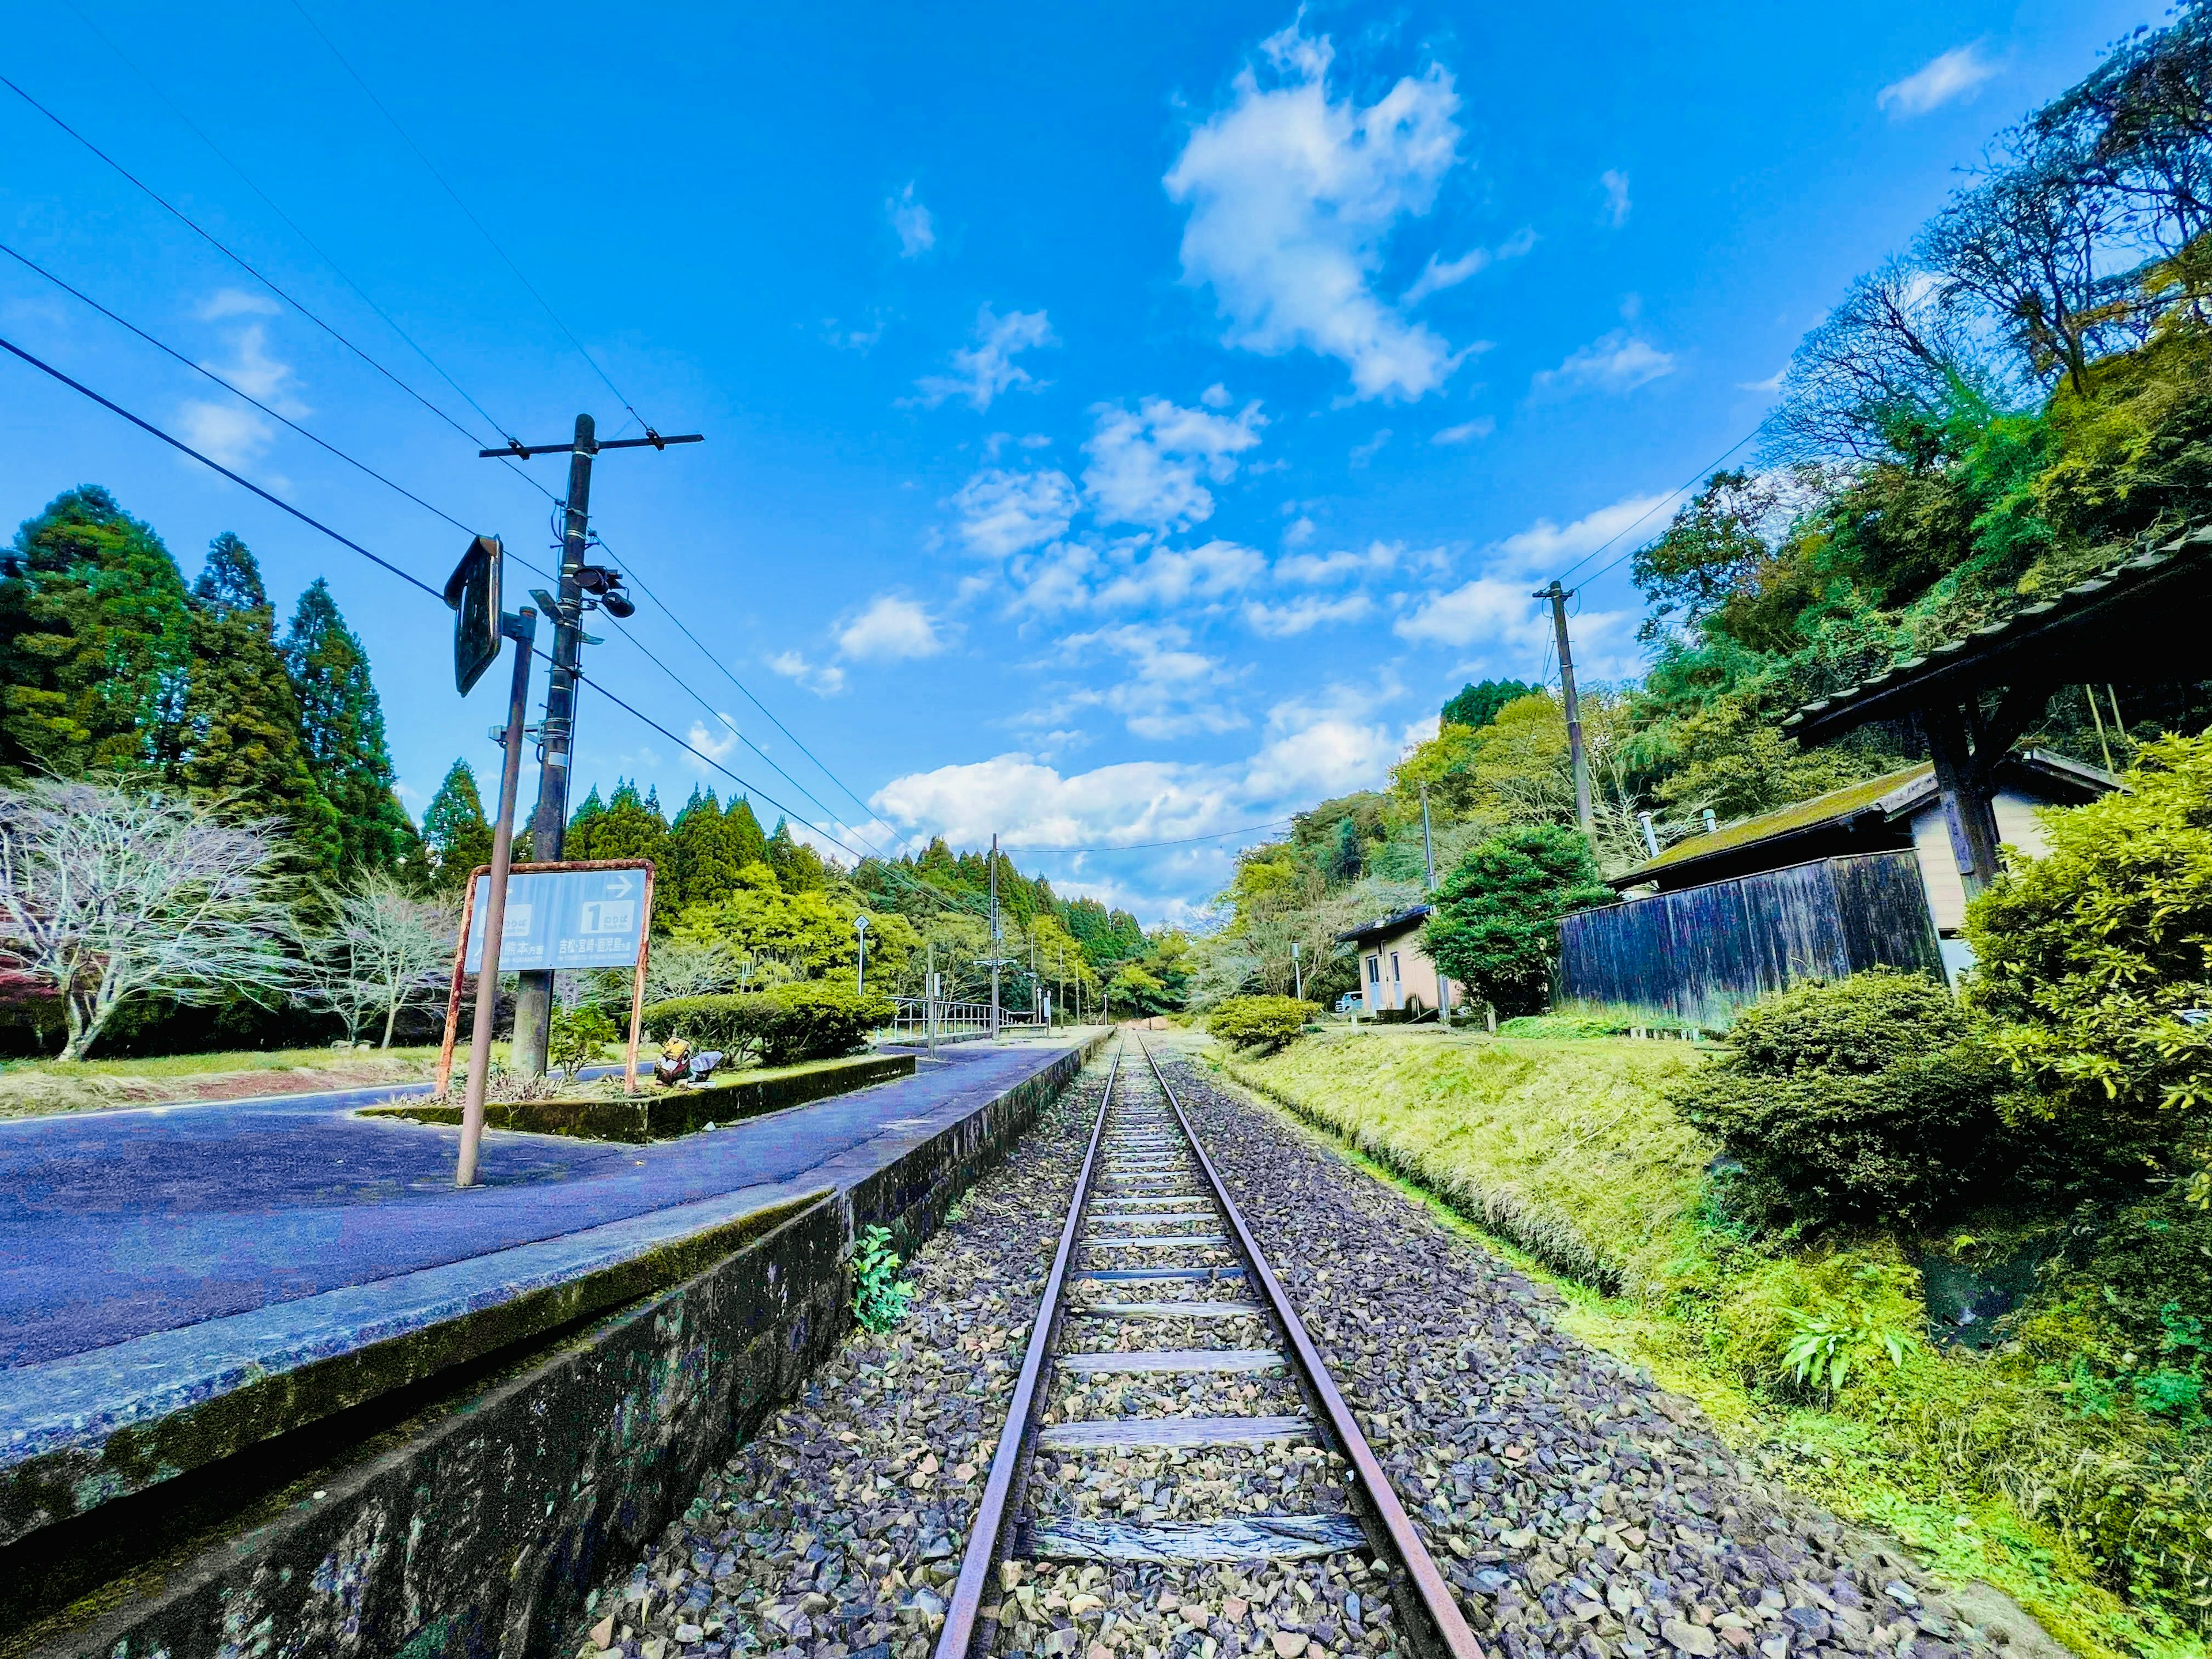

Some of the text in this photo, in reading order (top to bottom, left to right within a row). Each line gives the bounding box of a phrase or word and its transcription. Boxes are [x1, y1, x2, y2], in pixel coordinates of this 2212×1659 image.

[588, 904, 628, 930] 1 のりば
